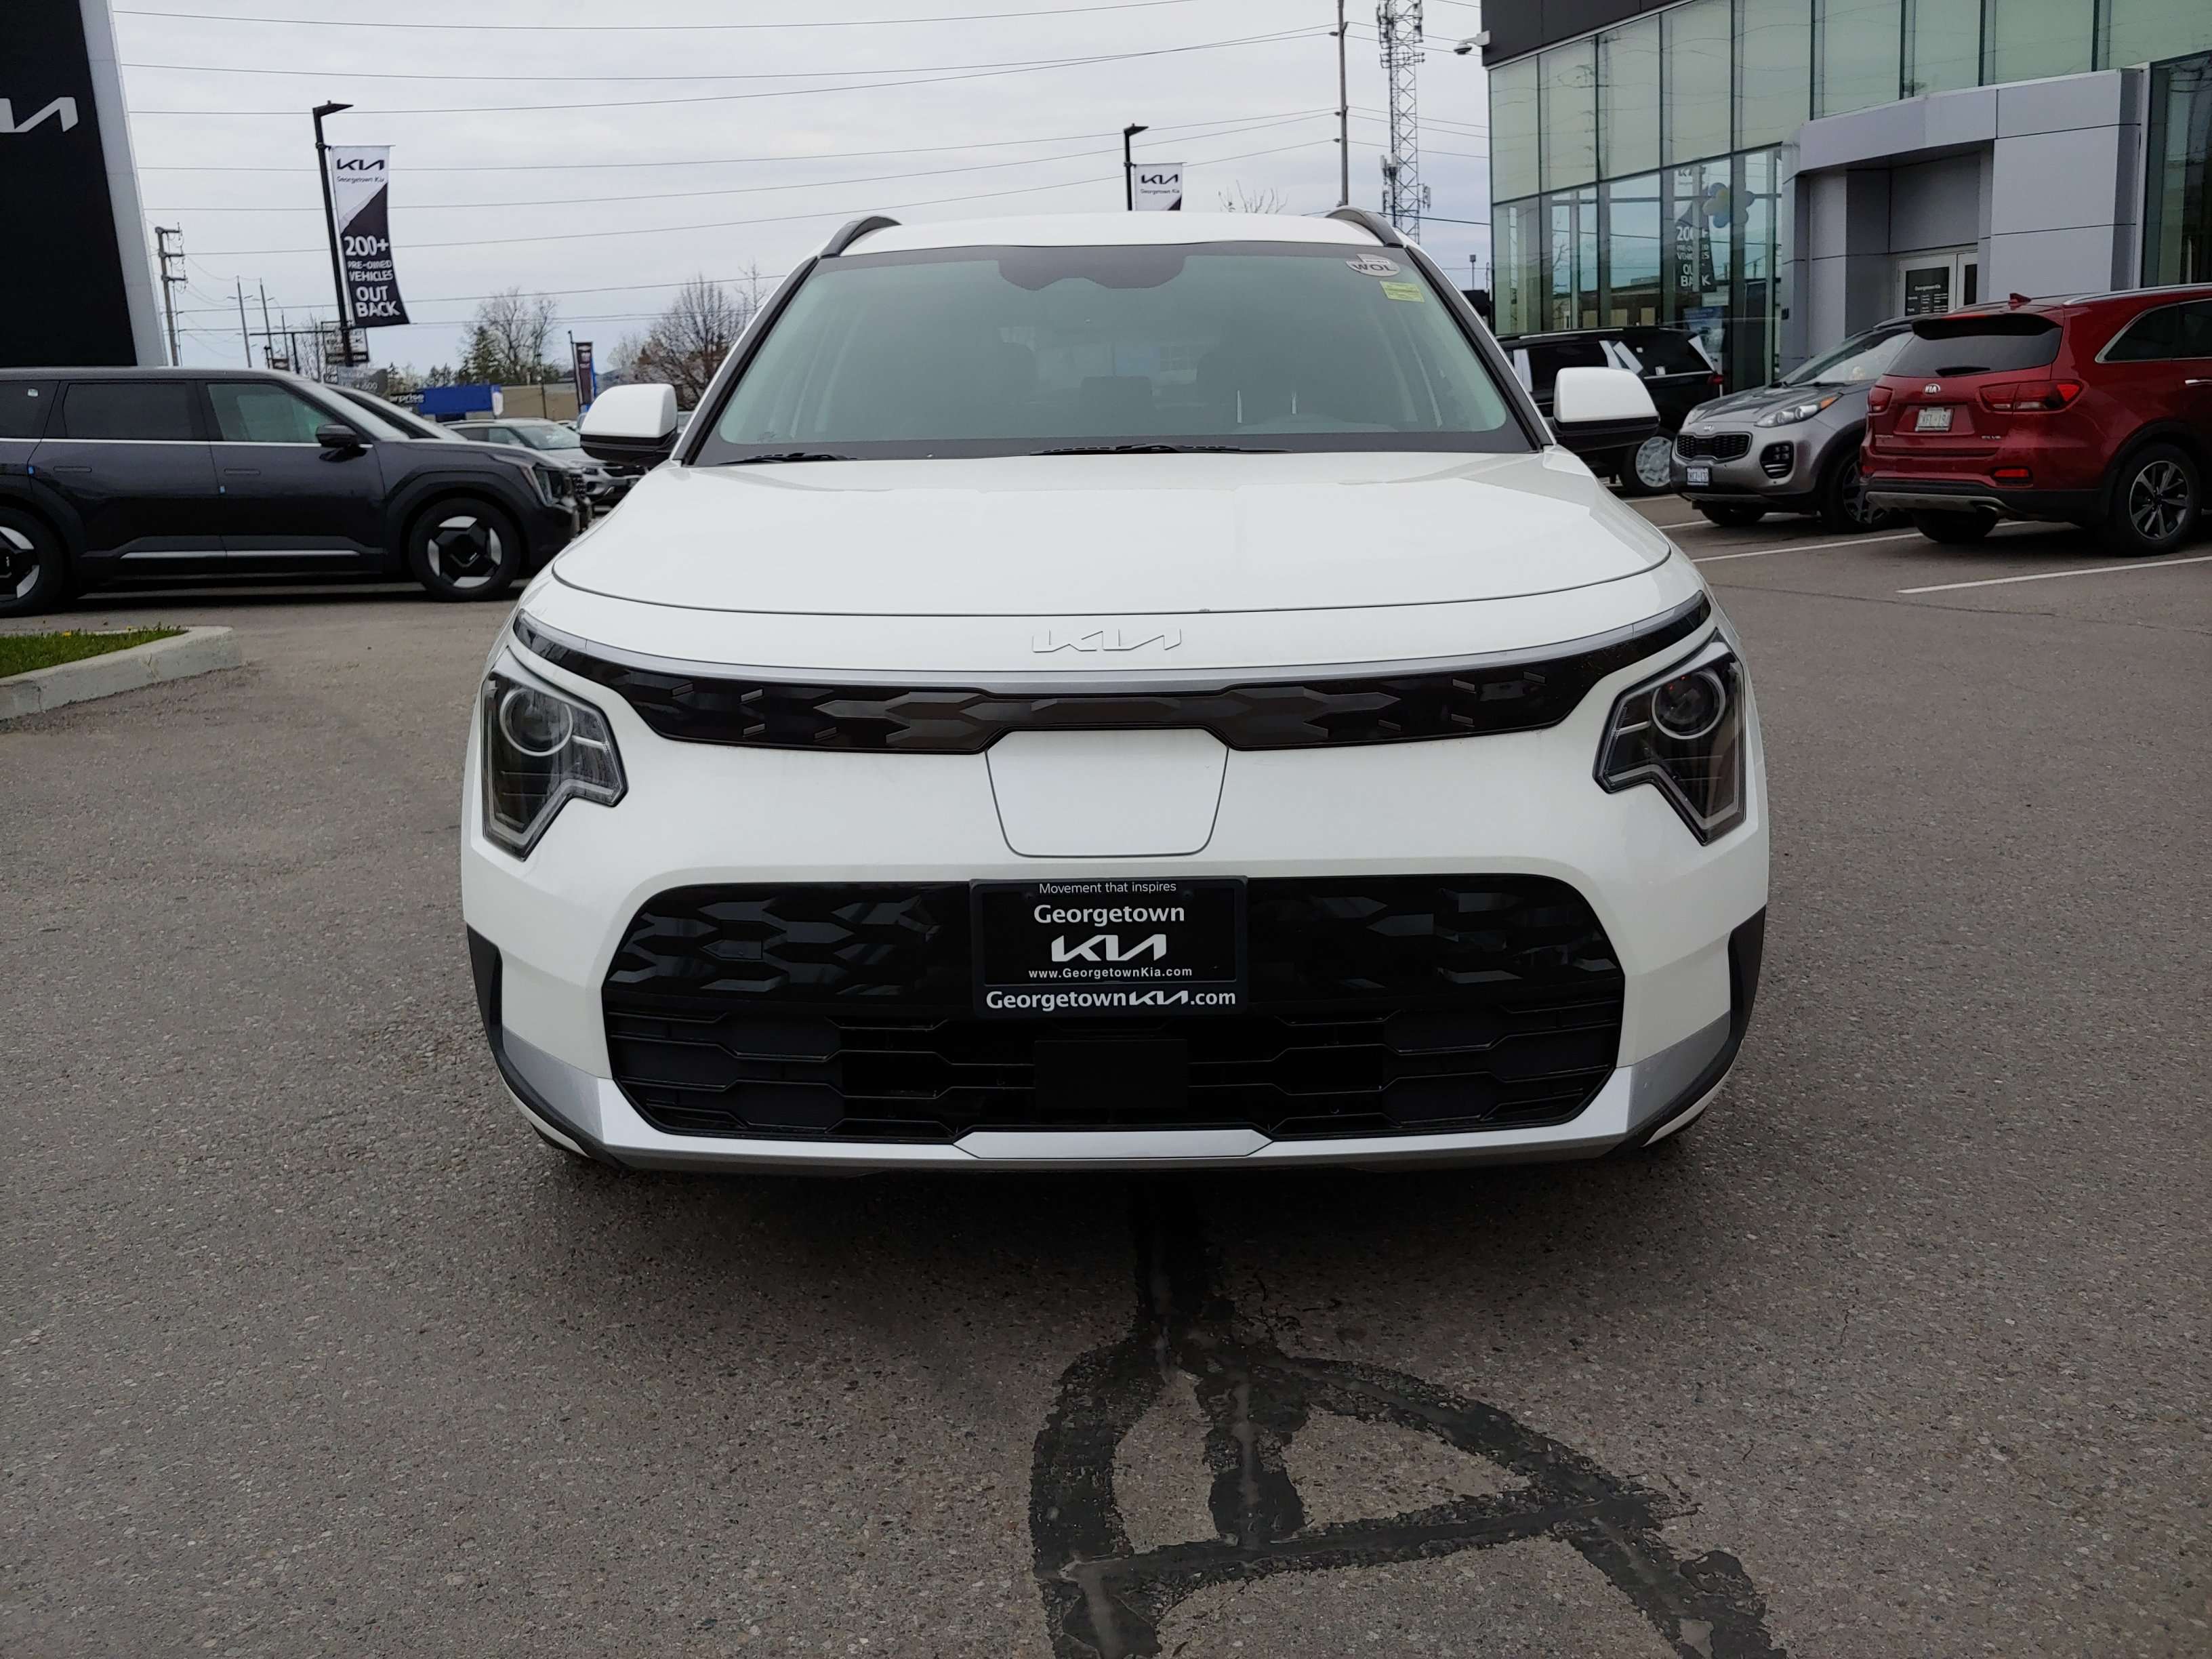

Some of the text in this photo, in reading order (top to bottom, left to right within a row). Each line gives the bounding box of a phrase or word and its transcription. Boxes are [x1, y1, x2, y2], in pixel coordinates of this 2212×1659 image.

[336, 158, 384, 171] KIA
[1141, 173, 1179, 185] KIA
[344, 235, 389, 257] 200+
[1352, 264, 1397, 272] WOL
[348, 269, 394, 282] VEHICLES
[356, 285, 388, 302] OUT
[355, 300, 401, 318] BACK
[1924, 384, 1938, 394] KIA
[1032, 629, 1182, 653] KIA
[1039, 881, 1177, 894] Movement that inspires
[1033, 905, 1185, 927] Georgetown
[1051, 934, 1167, 962] KIA
[1028, 966, 1193, 979] www.GeorgetownKia.com
